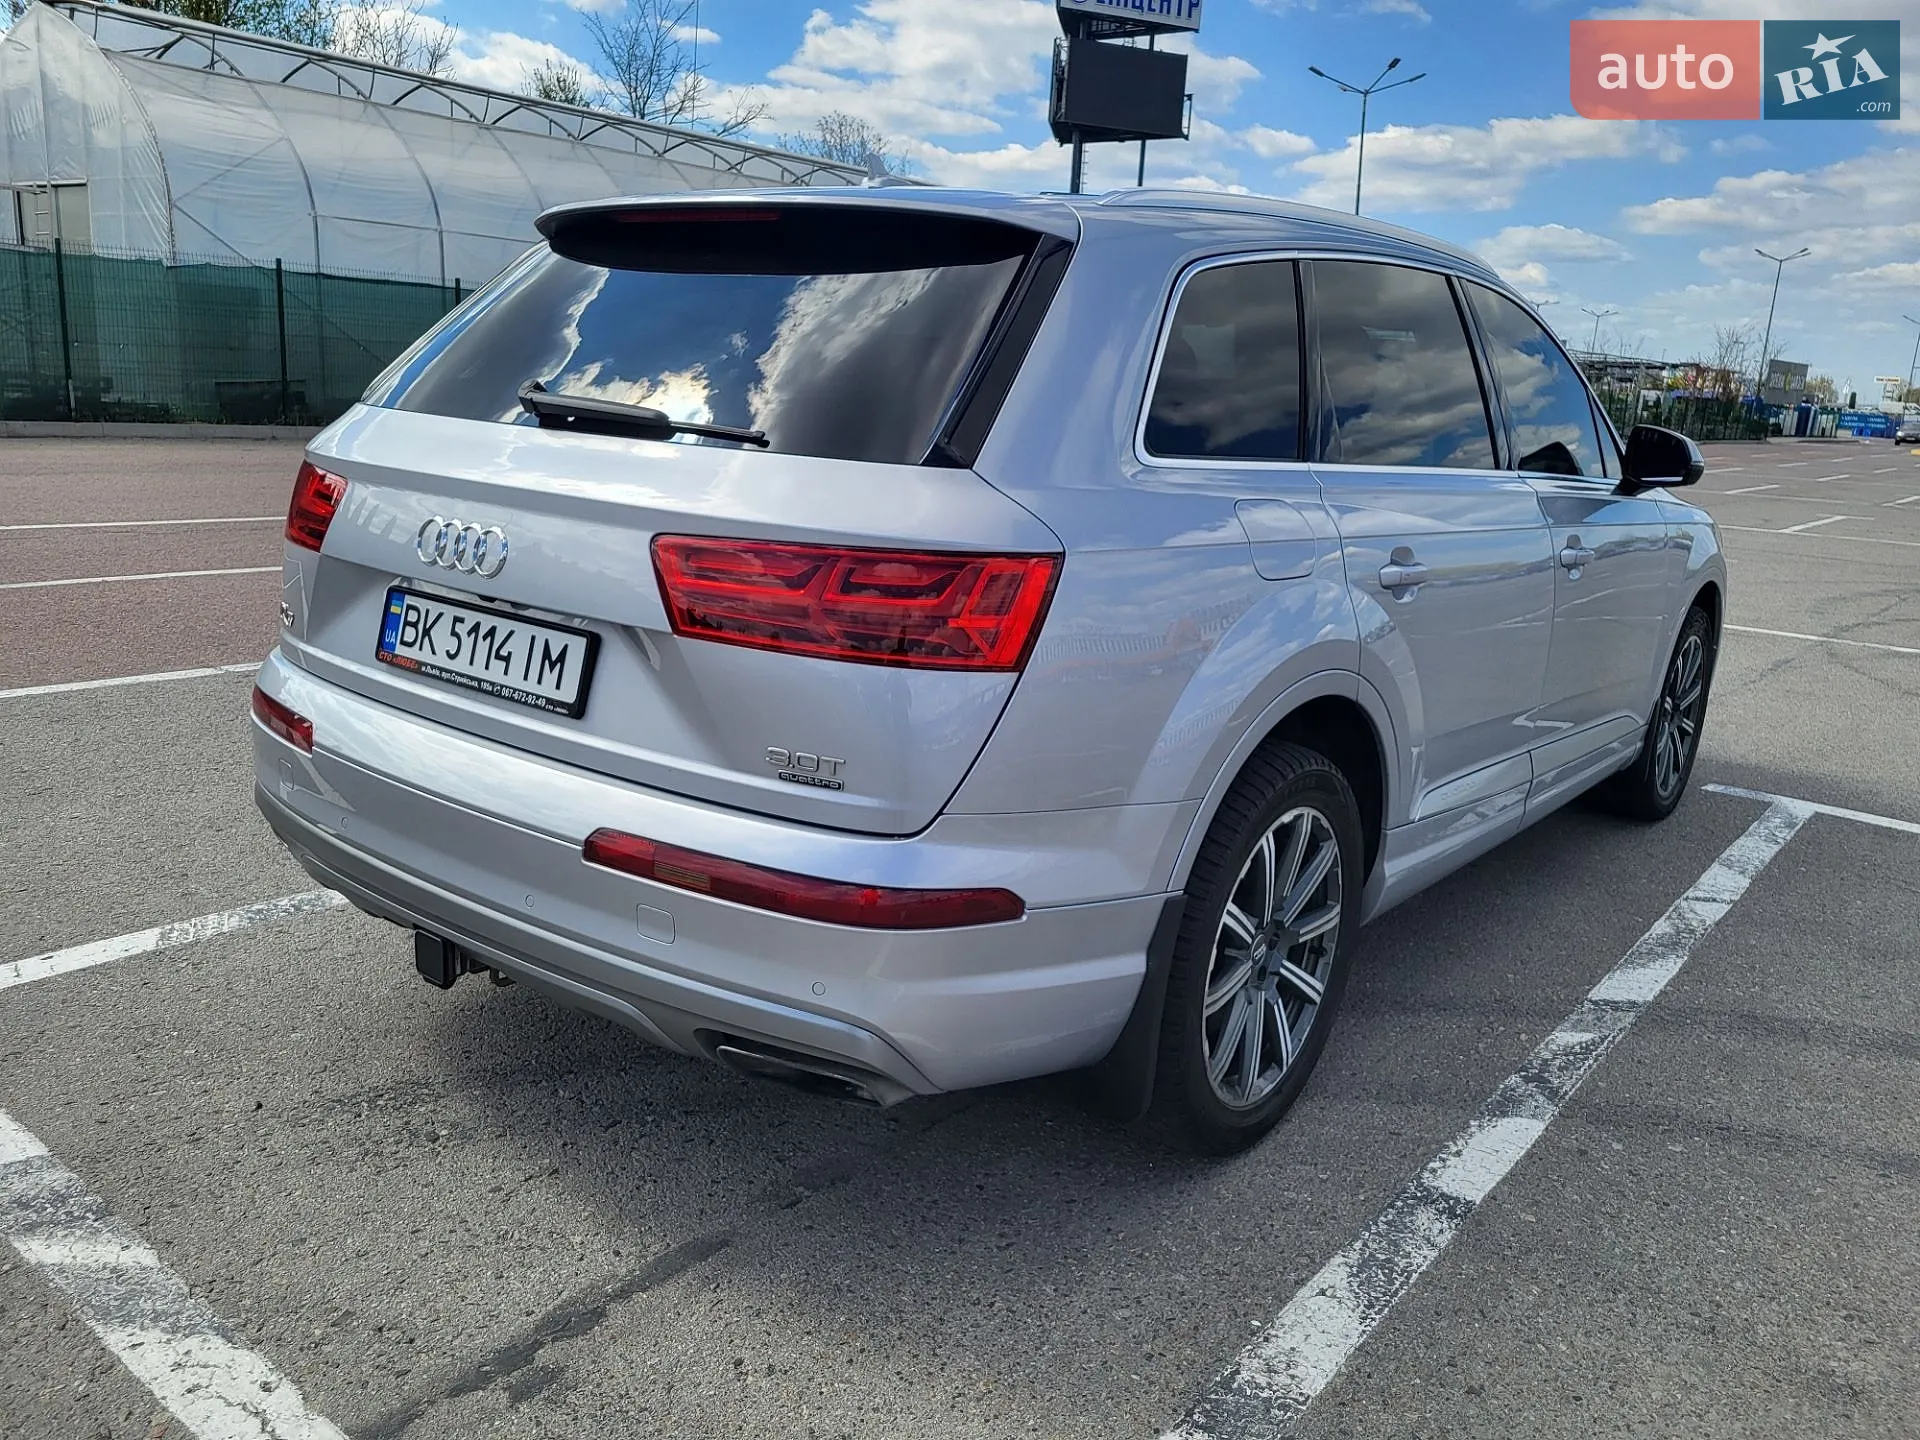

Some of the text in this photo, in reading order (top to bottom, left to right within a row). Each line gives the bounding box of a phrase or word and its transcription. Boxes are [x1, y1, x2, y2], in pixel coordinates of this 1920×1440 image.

[385, 628, 396, 644] UA
[399, 601, 569, 690] BK 5114 IM
[765, 746, 846, 776] 3.0T
[781, 772, 839, 788] quattro
